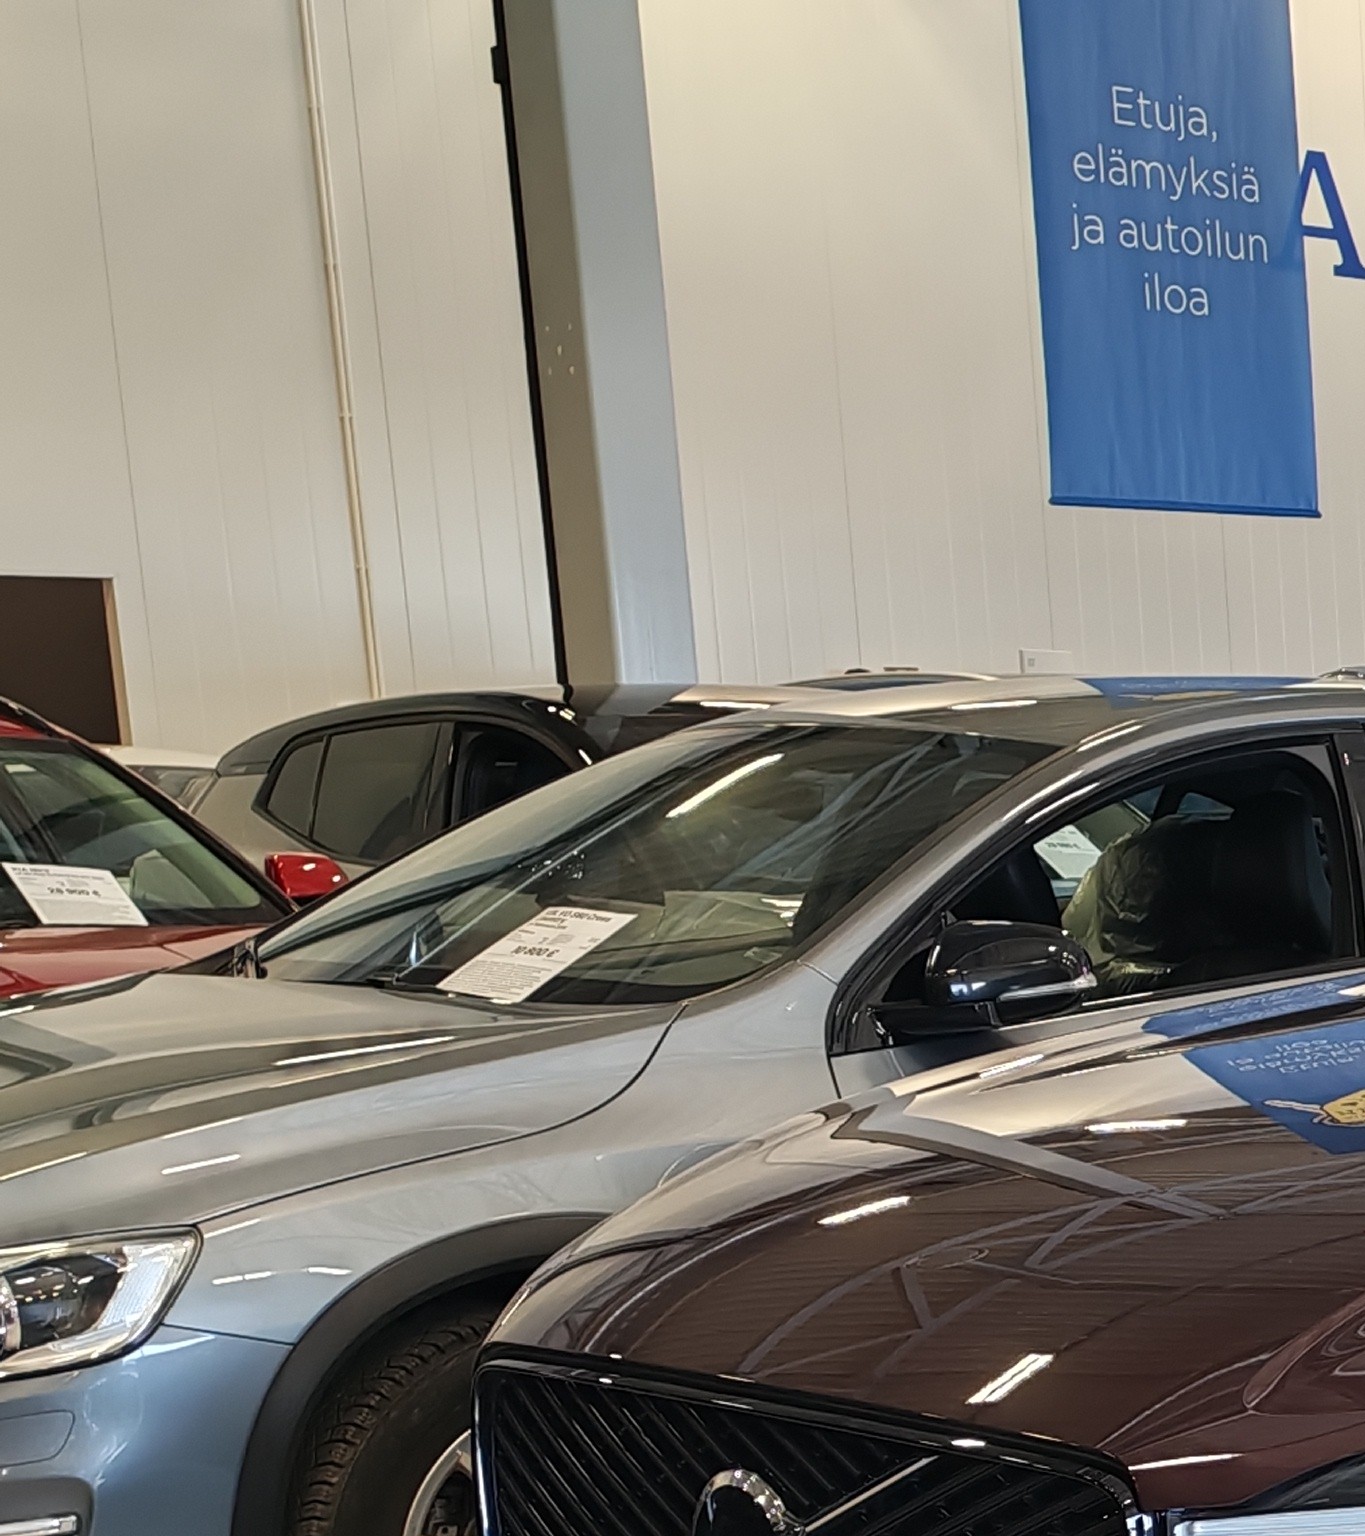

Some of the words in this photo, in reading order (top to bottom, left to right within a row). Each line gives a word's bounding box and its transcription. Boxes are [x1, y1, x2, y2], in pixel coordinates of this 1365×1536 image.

[1112, 85, 1218, 142] Etuja,
[1072, 143, 1260, 203] elämyksiä
[1071, 202, 1105, 250] ja
[1119, 215, 1268, 264] autoilun
[1144, 272, 1209, 316] iloa
